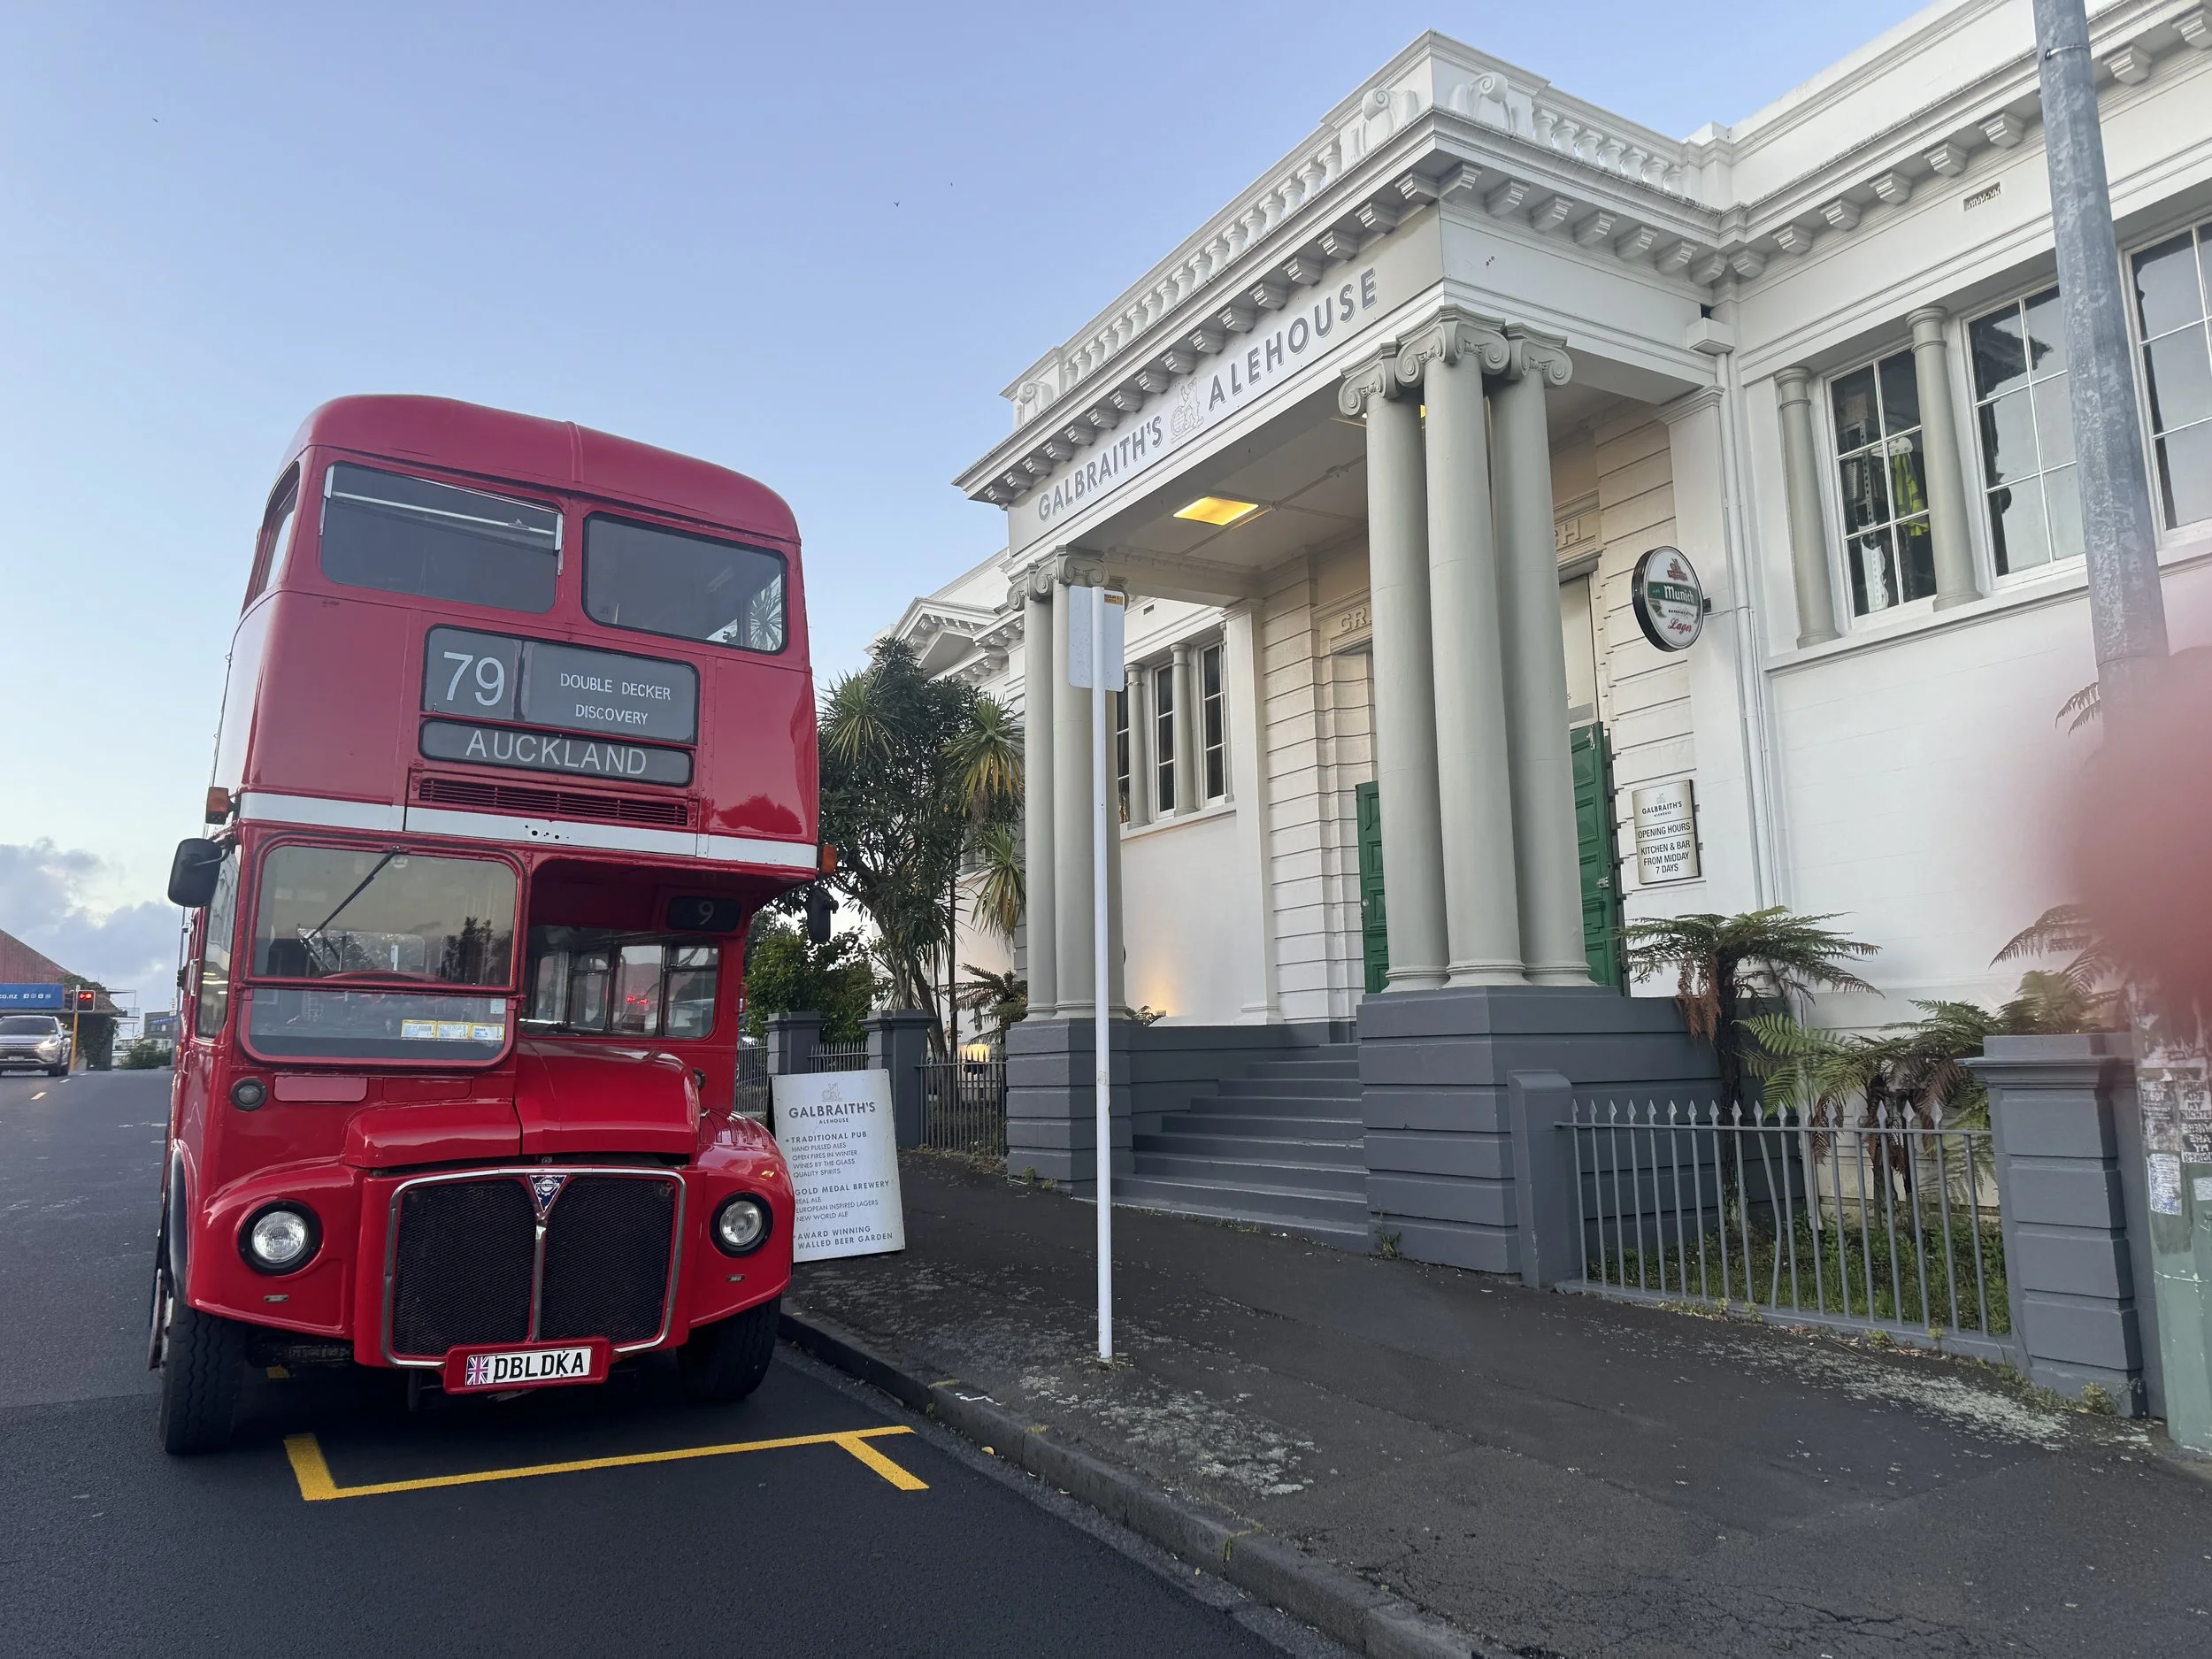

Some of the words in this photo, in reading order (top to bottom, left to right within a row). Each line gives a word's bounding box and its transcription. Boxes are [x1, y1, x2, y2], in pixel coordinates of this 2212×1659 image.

[1038, 415, 1163, 522] GALBRAITH'S
[1208, 267, 1378, 412] ALEHOUSE
[1663, 585, 1694, 603] Munich
[1340, 607, 1371, 633] GR
[1667, 618, 1692, 634] Lager
[443, 651, 505, 706] 79
[560, 673, 613, 694] DOUBLE
[621, 681, 671, 700] DECKER
[575, 704, 649, 725] DISCOVERY
[465, 729, 647, 775] AUCKLAND
[1641, 801, 1682, 815] GALBRAITH'S
[1638, 826, 1666, 839] OPENING
[1667, 822, 1691, 833] HOURS
[1640, 843, 1669, 856] KITCHEN
[1677, 840, 1691, 849] BAR
[1643, 856, 1663, 866] FROM
[1663, 851, 1690, 863] MIDDAY
[1662, 864, 1679, 873] DAYS
[698, 901, 714, 926] 9
[788, 1102, 876, 1118] GALBRAITH'S
[791, 1133, 848, 1143] TRADITIONAL
[793, 1170, 819, 1179] QUALITY
[821, 1185, 849, 1194] MEDAL
[853, 1180, 889, 1190] BREWERY
[829, 1202, 856, 1210] INSPIRED
[797, 1231, 829, 1240] AWARD
[832, 1225, 871, 1236] WINNING
[797, 1240, 832, 1249] WALLED
[834, 1237, 855, 1246] BEER
[857, 1233, 893, 1242] GARDEN
[494, 1352, 584, 1380] DBLDKA
